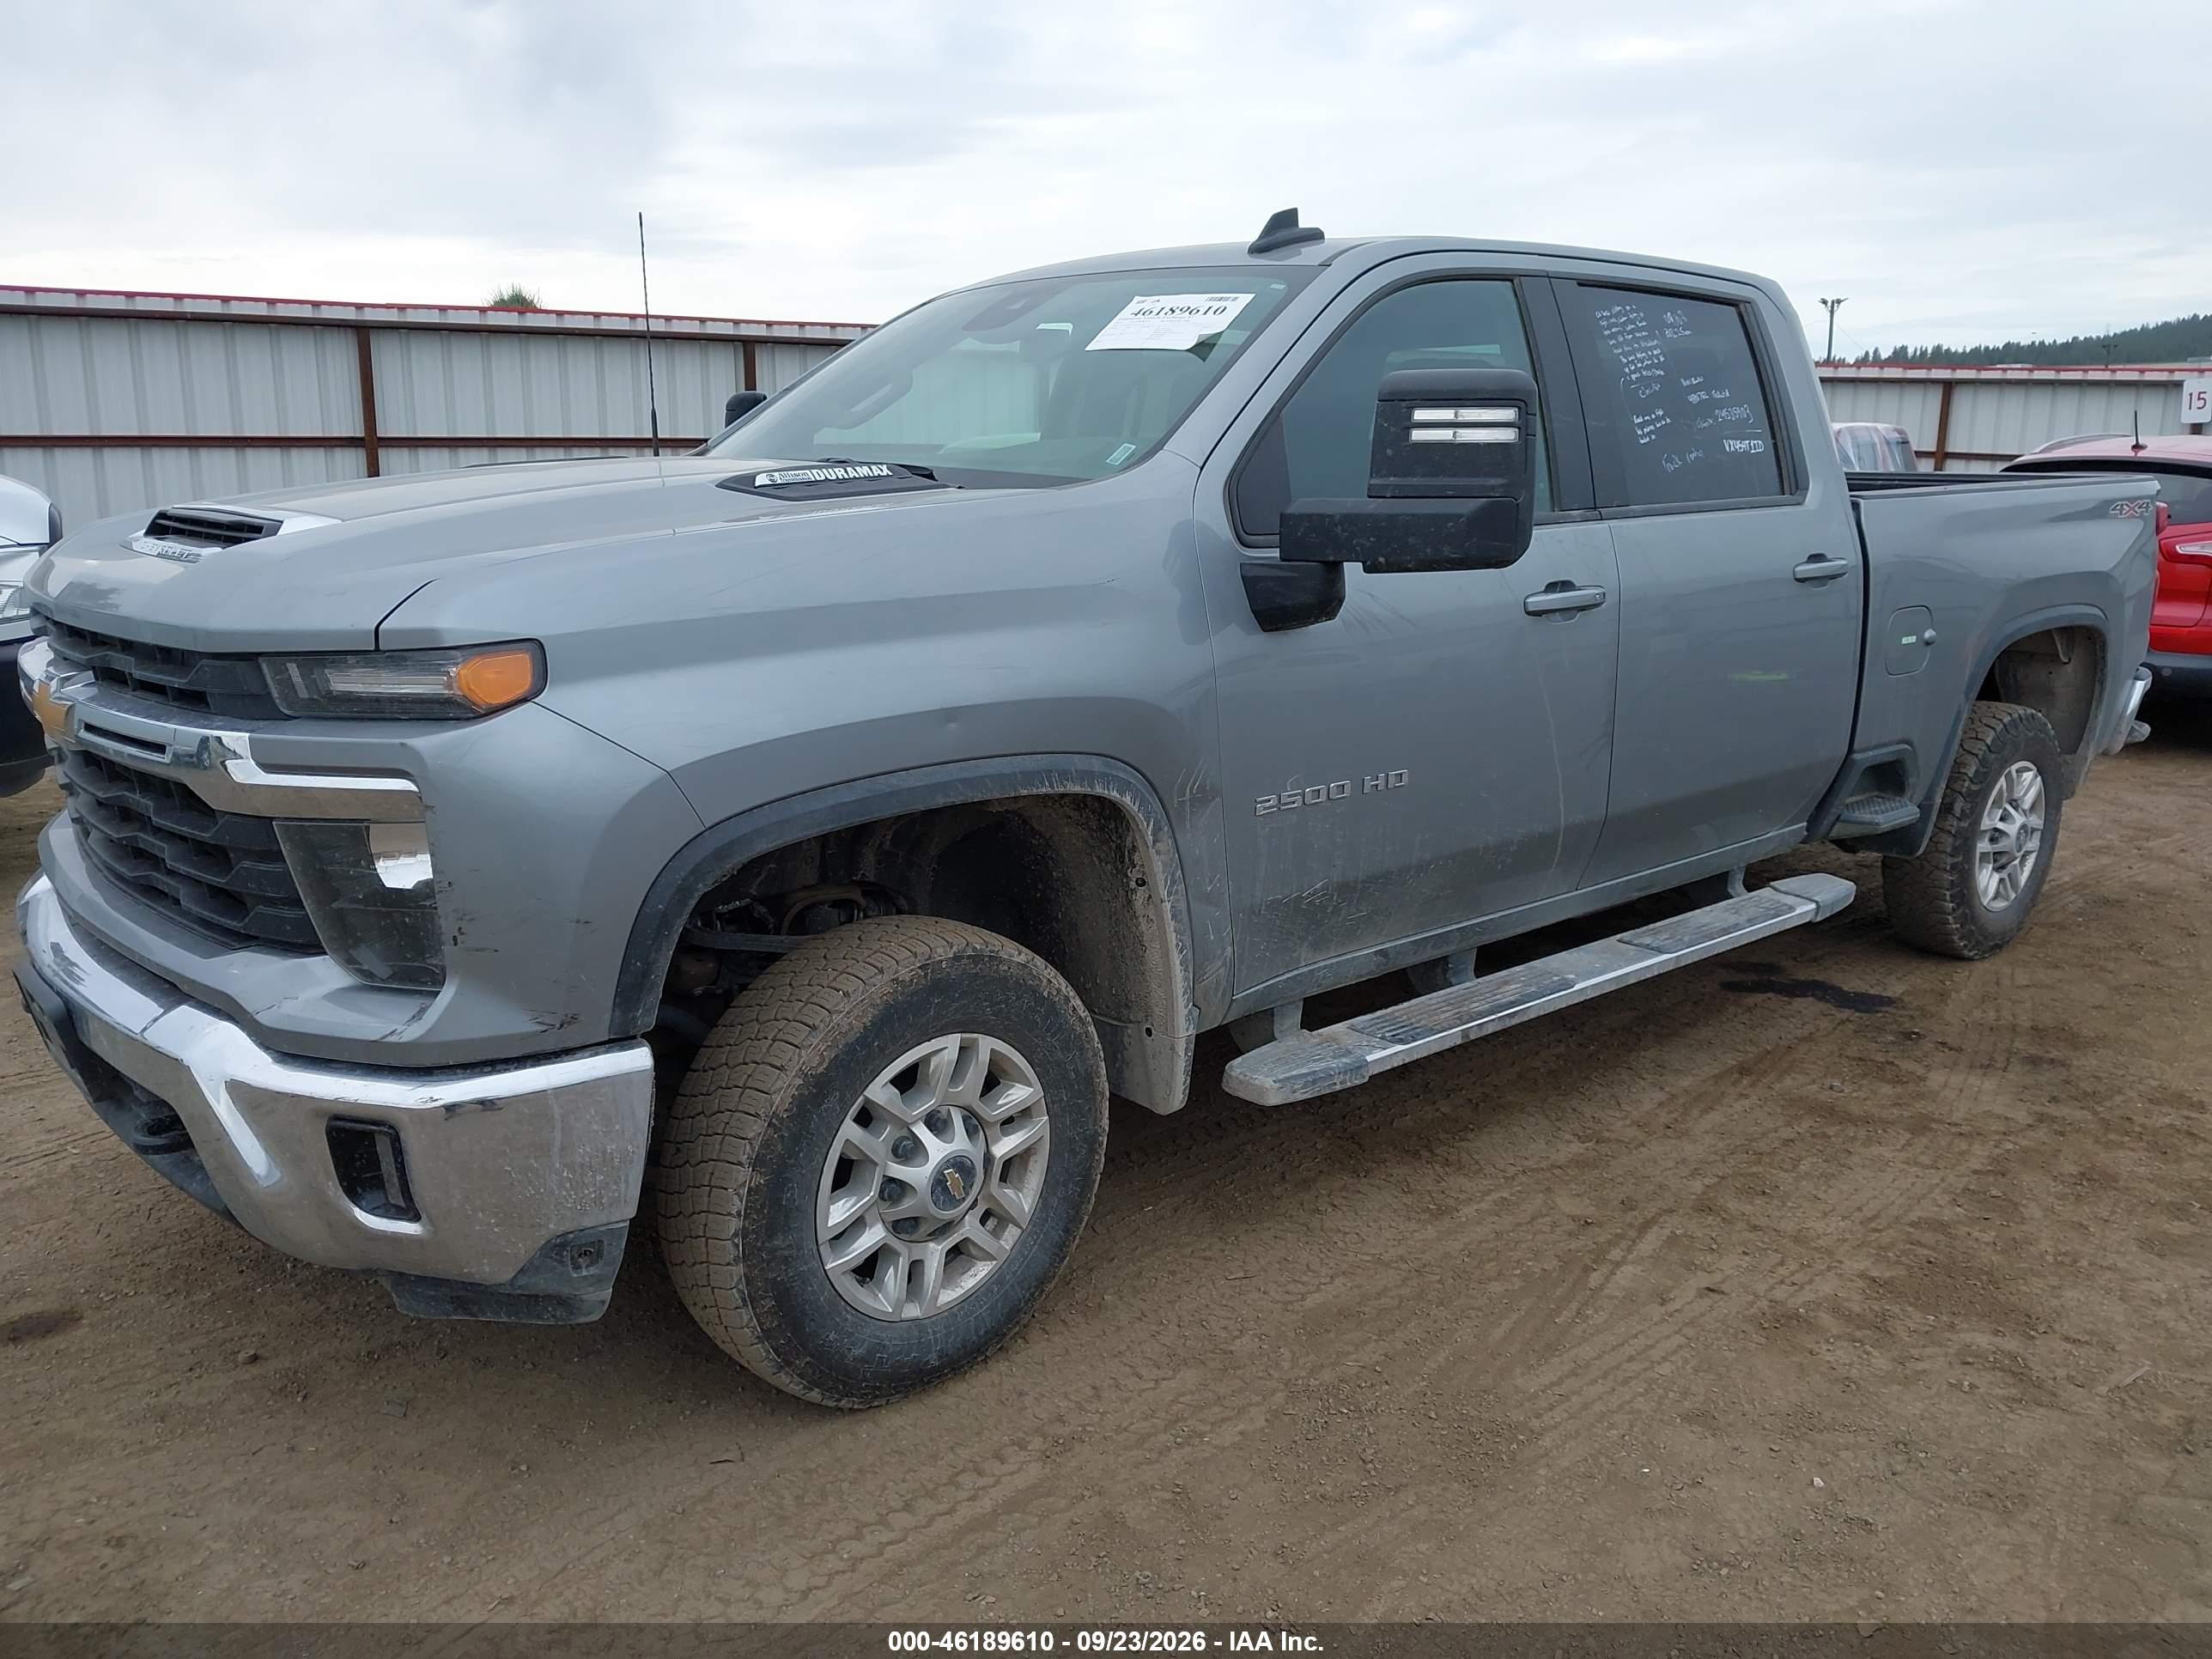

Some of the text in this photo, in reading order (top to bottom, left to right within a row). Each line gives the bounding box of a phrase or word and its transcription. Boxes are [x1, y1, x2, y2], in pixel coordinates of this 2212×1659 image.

[1130, 305, 1228, 317] 46189610
[2188, 391, 2208, 410] 15
[778, 471, 810, 481] Allison
[811, 464, 894, 482] DURAMAX
[1255, 769, 1409, 817] 2500 HD
